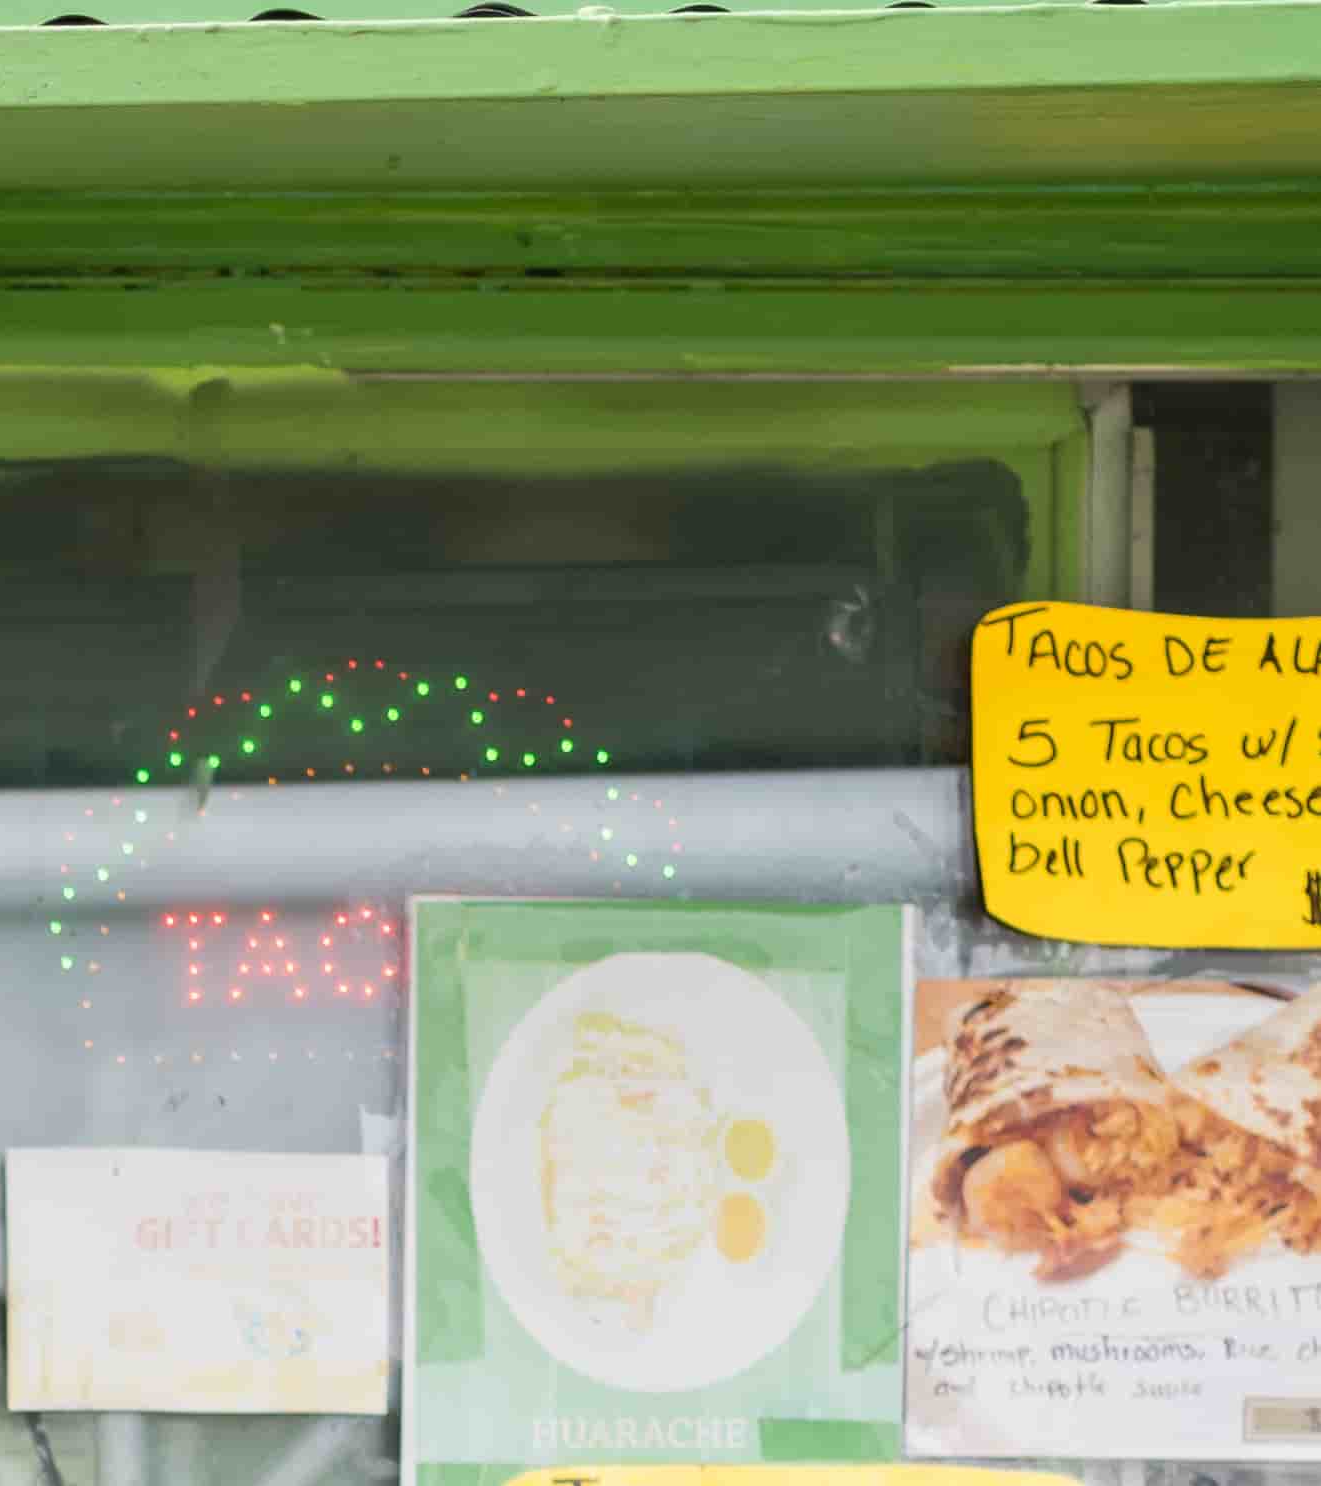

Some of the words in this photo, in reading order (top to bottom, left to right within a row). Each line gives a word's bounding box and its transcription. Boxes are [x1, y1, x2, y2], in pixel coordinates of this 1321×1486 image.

[981, 607, 1134, 680] TACOS
[1165, 635, 1231, 676] DE
[1007, 718, 1057, 768] 5
[1089, 717, 1209, 765] Tacos
[1241, 716, 1298, 767] w/
[1009, 831, 1085, 879] bell
[530, 1416, 751, 1450] HUARACHE
